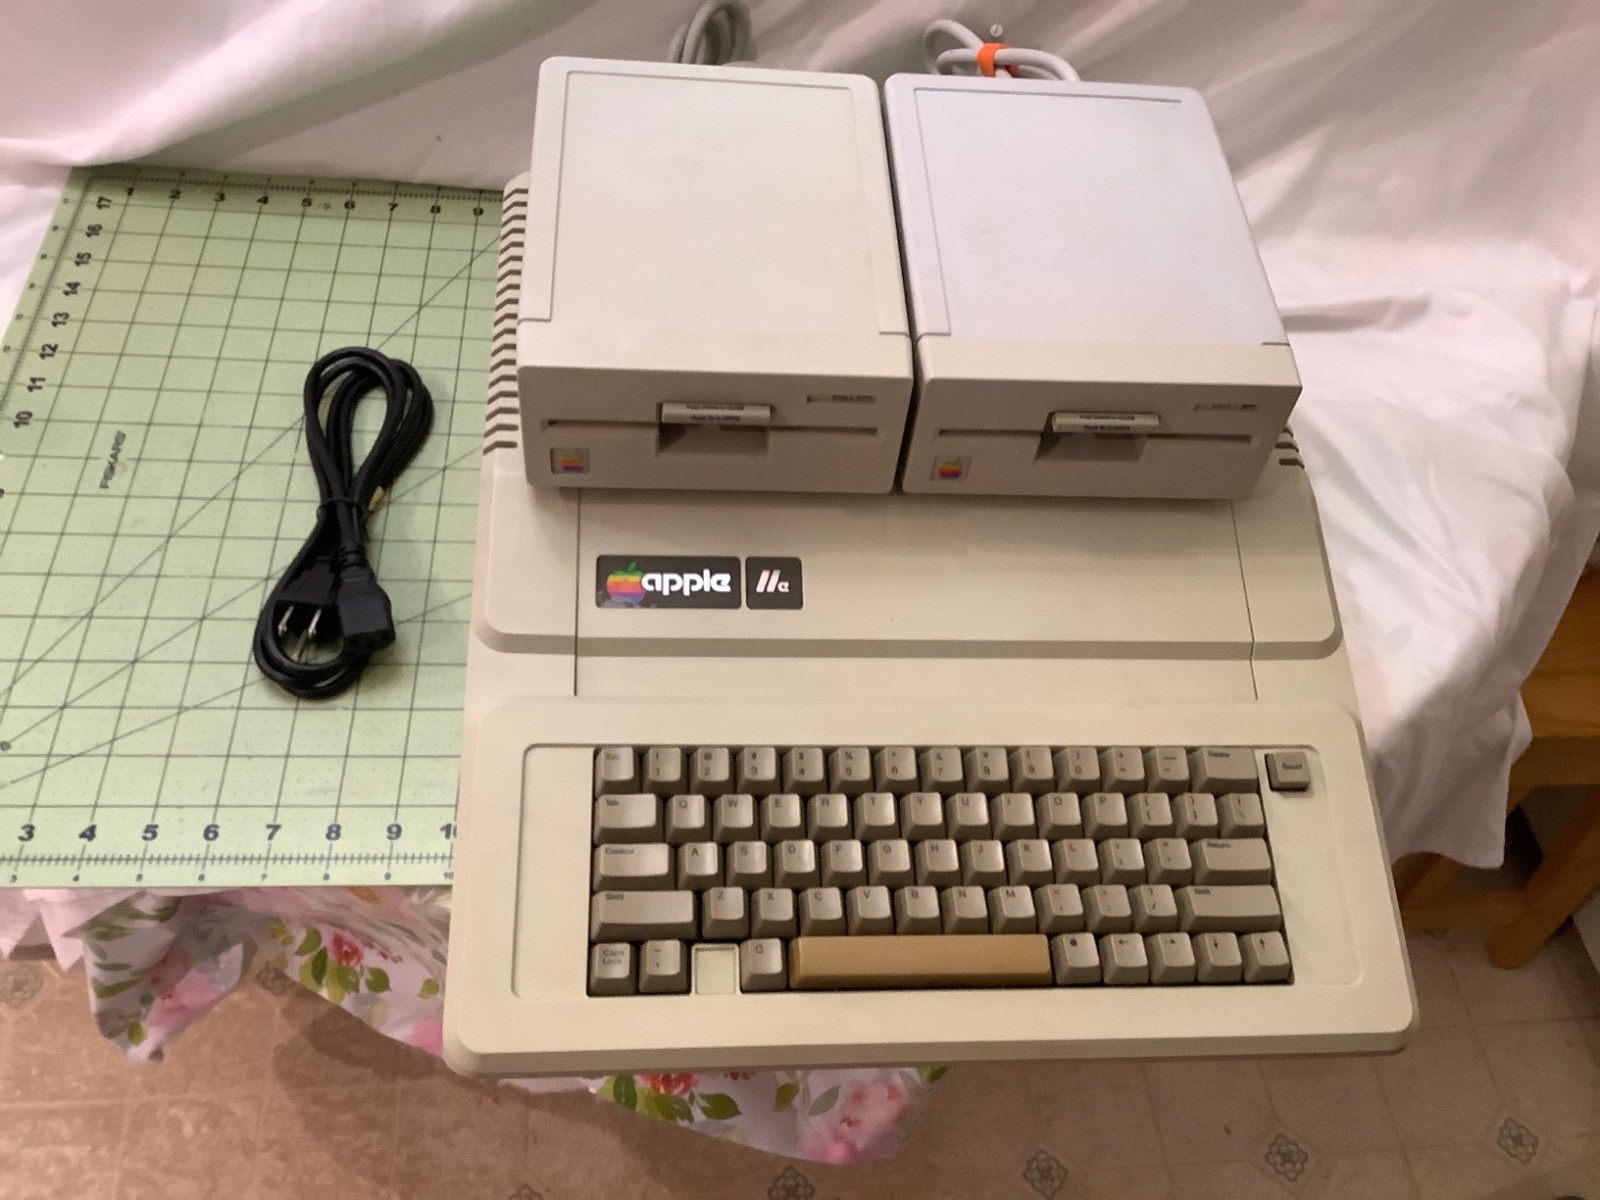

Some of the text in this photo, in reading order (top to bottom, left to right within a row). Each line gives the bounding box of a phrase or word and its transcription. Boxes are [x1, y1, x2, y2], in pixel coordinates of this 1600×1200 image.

[96, 196, 112, 209] 17
[168, 189, 181, 199] 2
[256, 195, 269, 205] 4
[301, 197, 313, 208] 5
[344, 200, 355, 209] 6
[388, 202, 399, 211] 7
[430, 204, 441, 214] 8
[473, 206, 484, 216] 9
[85, 223, 102, 238] 16
[74, 252, 92, 267] 15
[63, 281, 81, 296] 14
[51, 312, 70, 328] 13
[39, 343, 59, 360] 12
[26, 377, 46, 393] 11
[13, 410, 33, 429] 10
[641, 568, 732, 596] apple
[727, 799, 738, 808] W
[18, 823, 458, 842] 3 4 5 6 7 8 9 1
[1006, 889, 1016, 898] M
